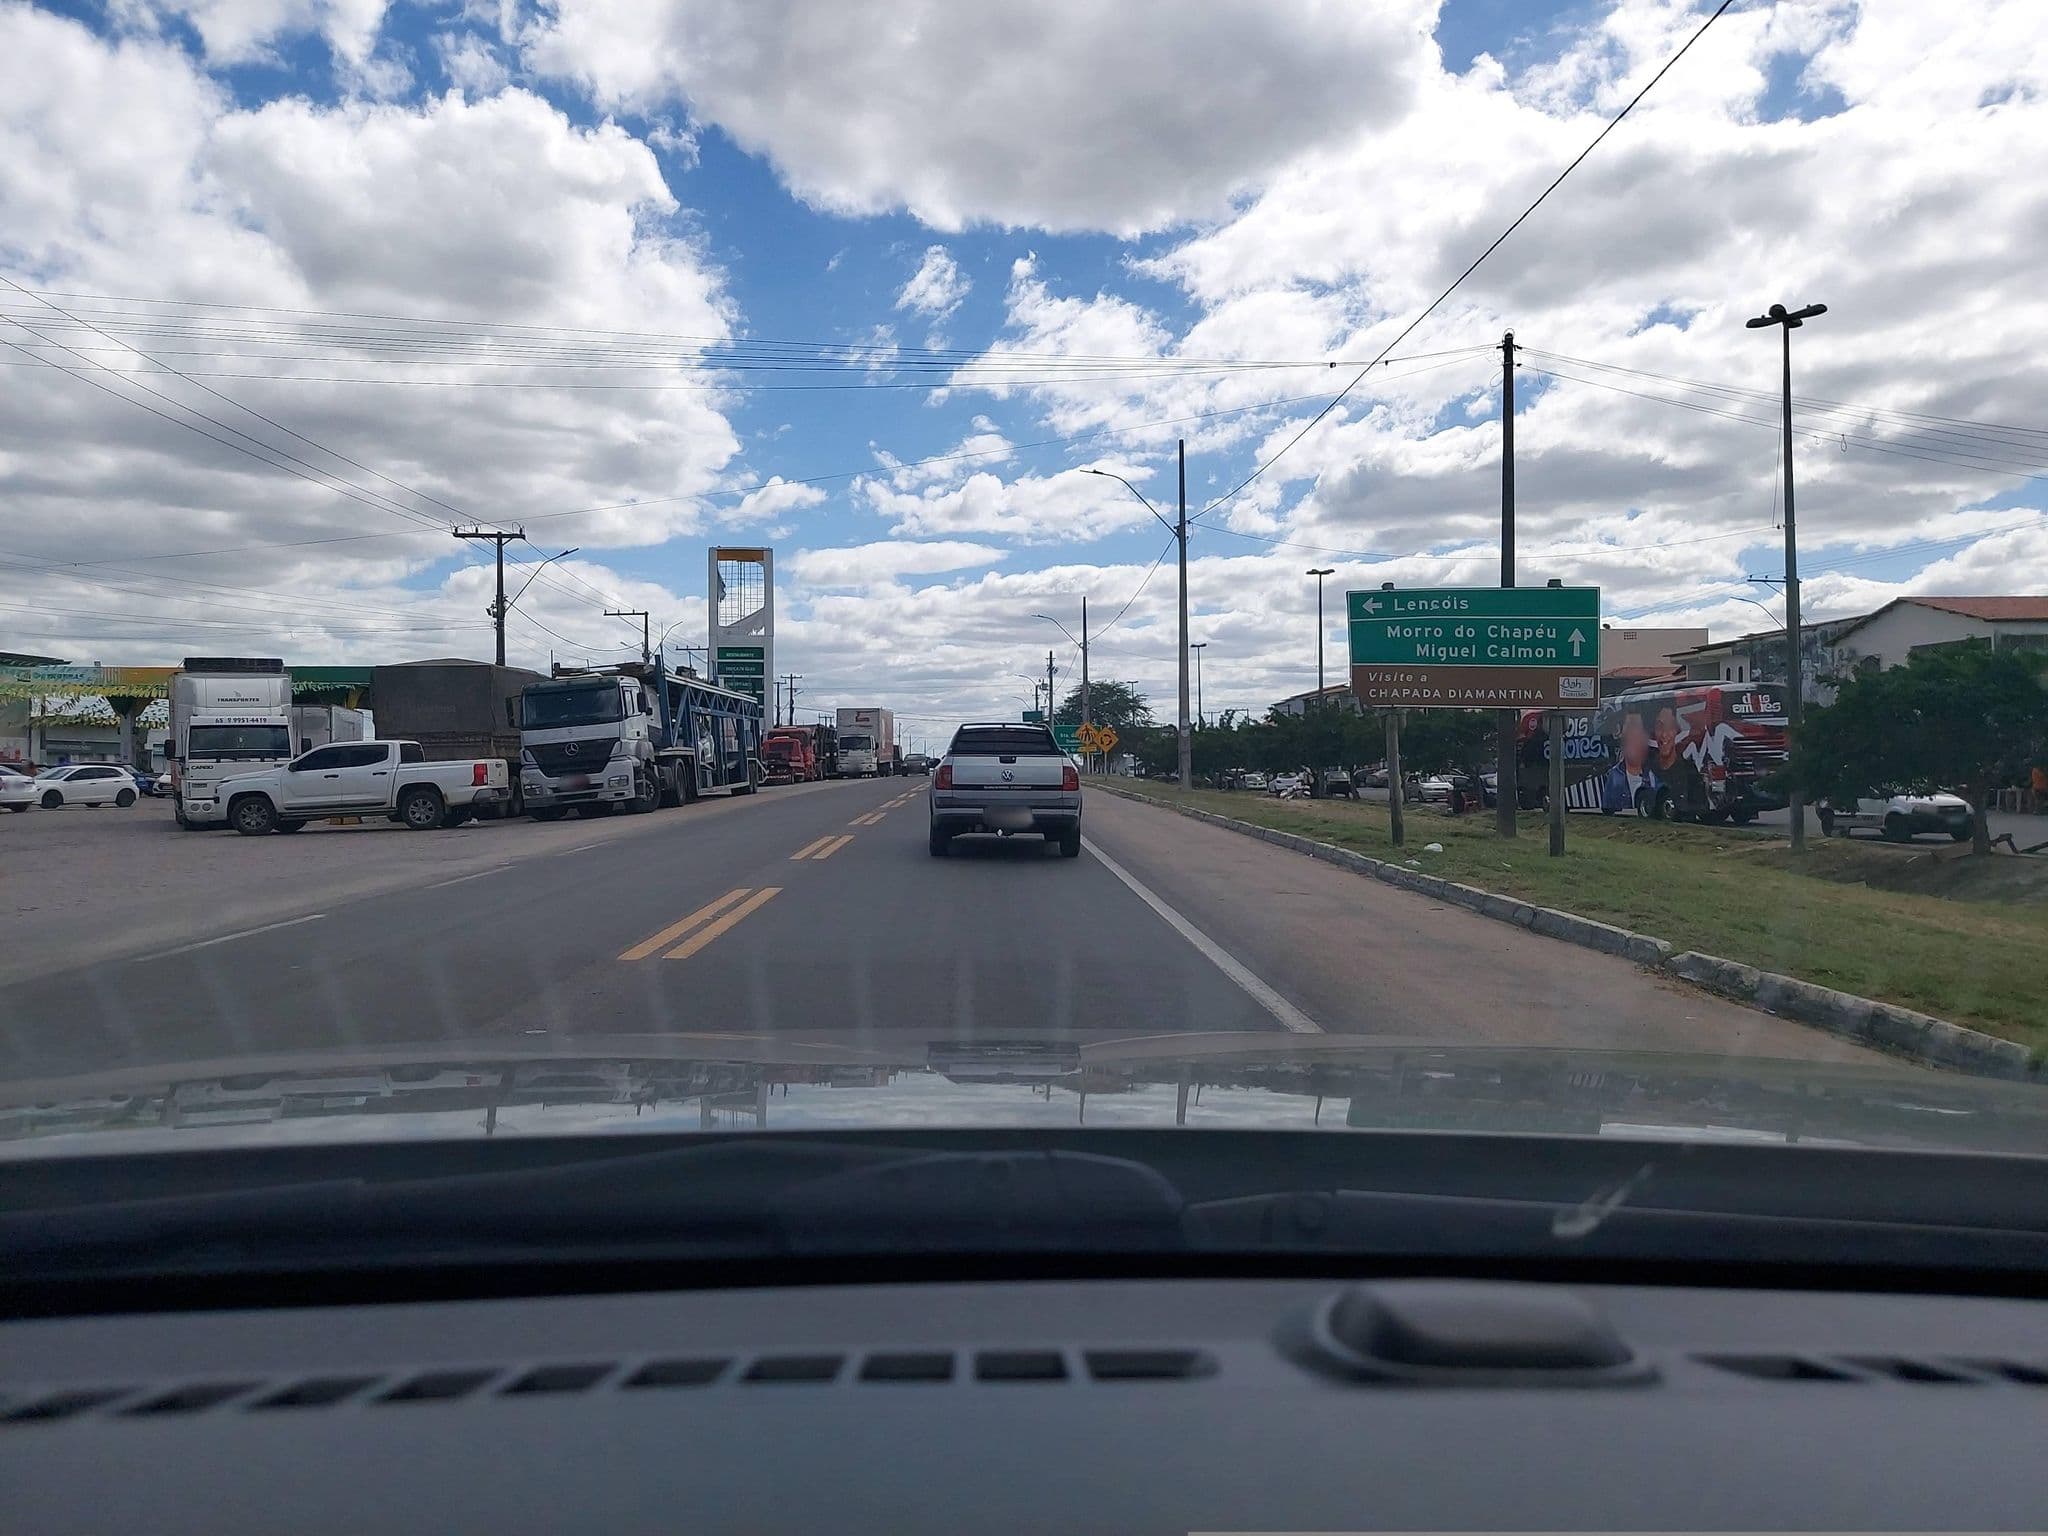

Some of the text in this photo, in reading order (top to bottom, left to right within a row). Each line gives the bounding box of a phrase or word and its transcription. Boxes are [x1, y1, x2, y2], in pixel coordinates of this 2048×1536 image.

[1393, 595, 1469, 612] Lençóis
[1387, 623, 1557, 641] Morro do Chapéu
[1416, 643, 1557, 662] Miguel Calmon
[1368, 672, 1428, 682] Visite a
[1368, 688, 1544, 700] CHAPADA DIAMANTINA
